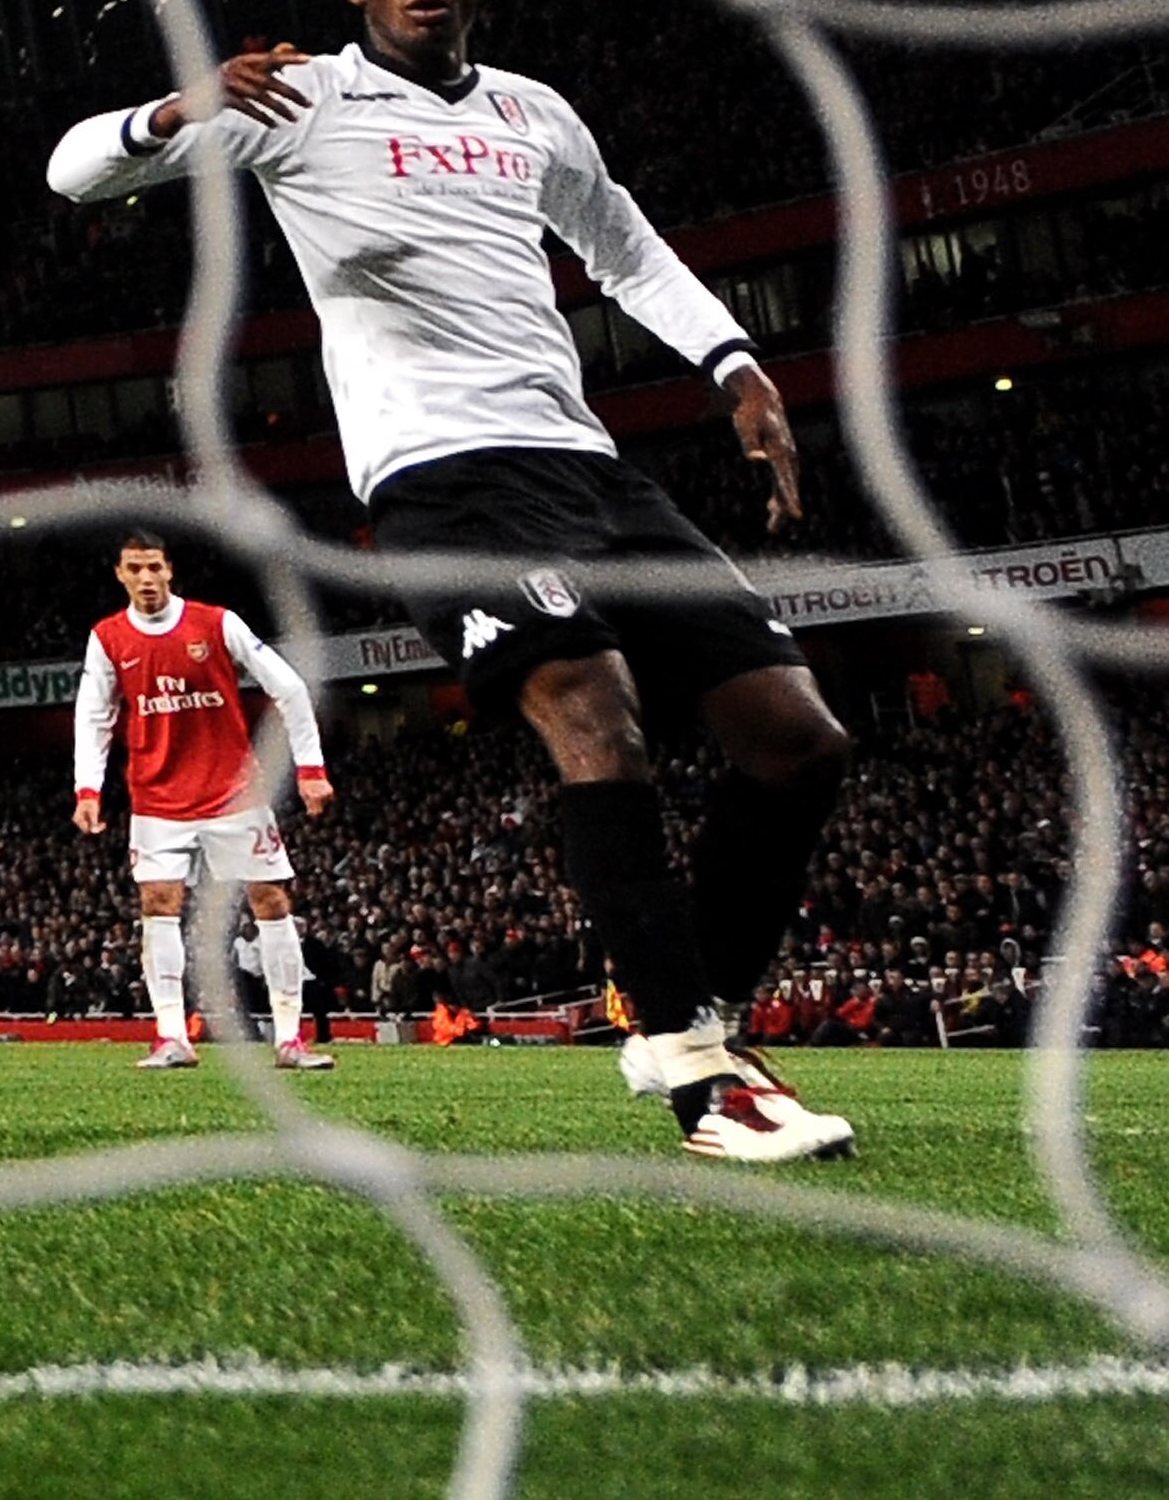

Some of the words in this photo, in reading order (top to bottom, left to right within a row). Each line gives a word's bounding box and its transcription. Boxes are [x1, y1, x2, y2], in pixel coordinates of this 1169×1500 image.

[386, 134, 531, 182] FxPro
[955, 159, 1032, 206] 1948
[137, 690, 225, 717] Emirates
